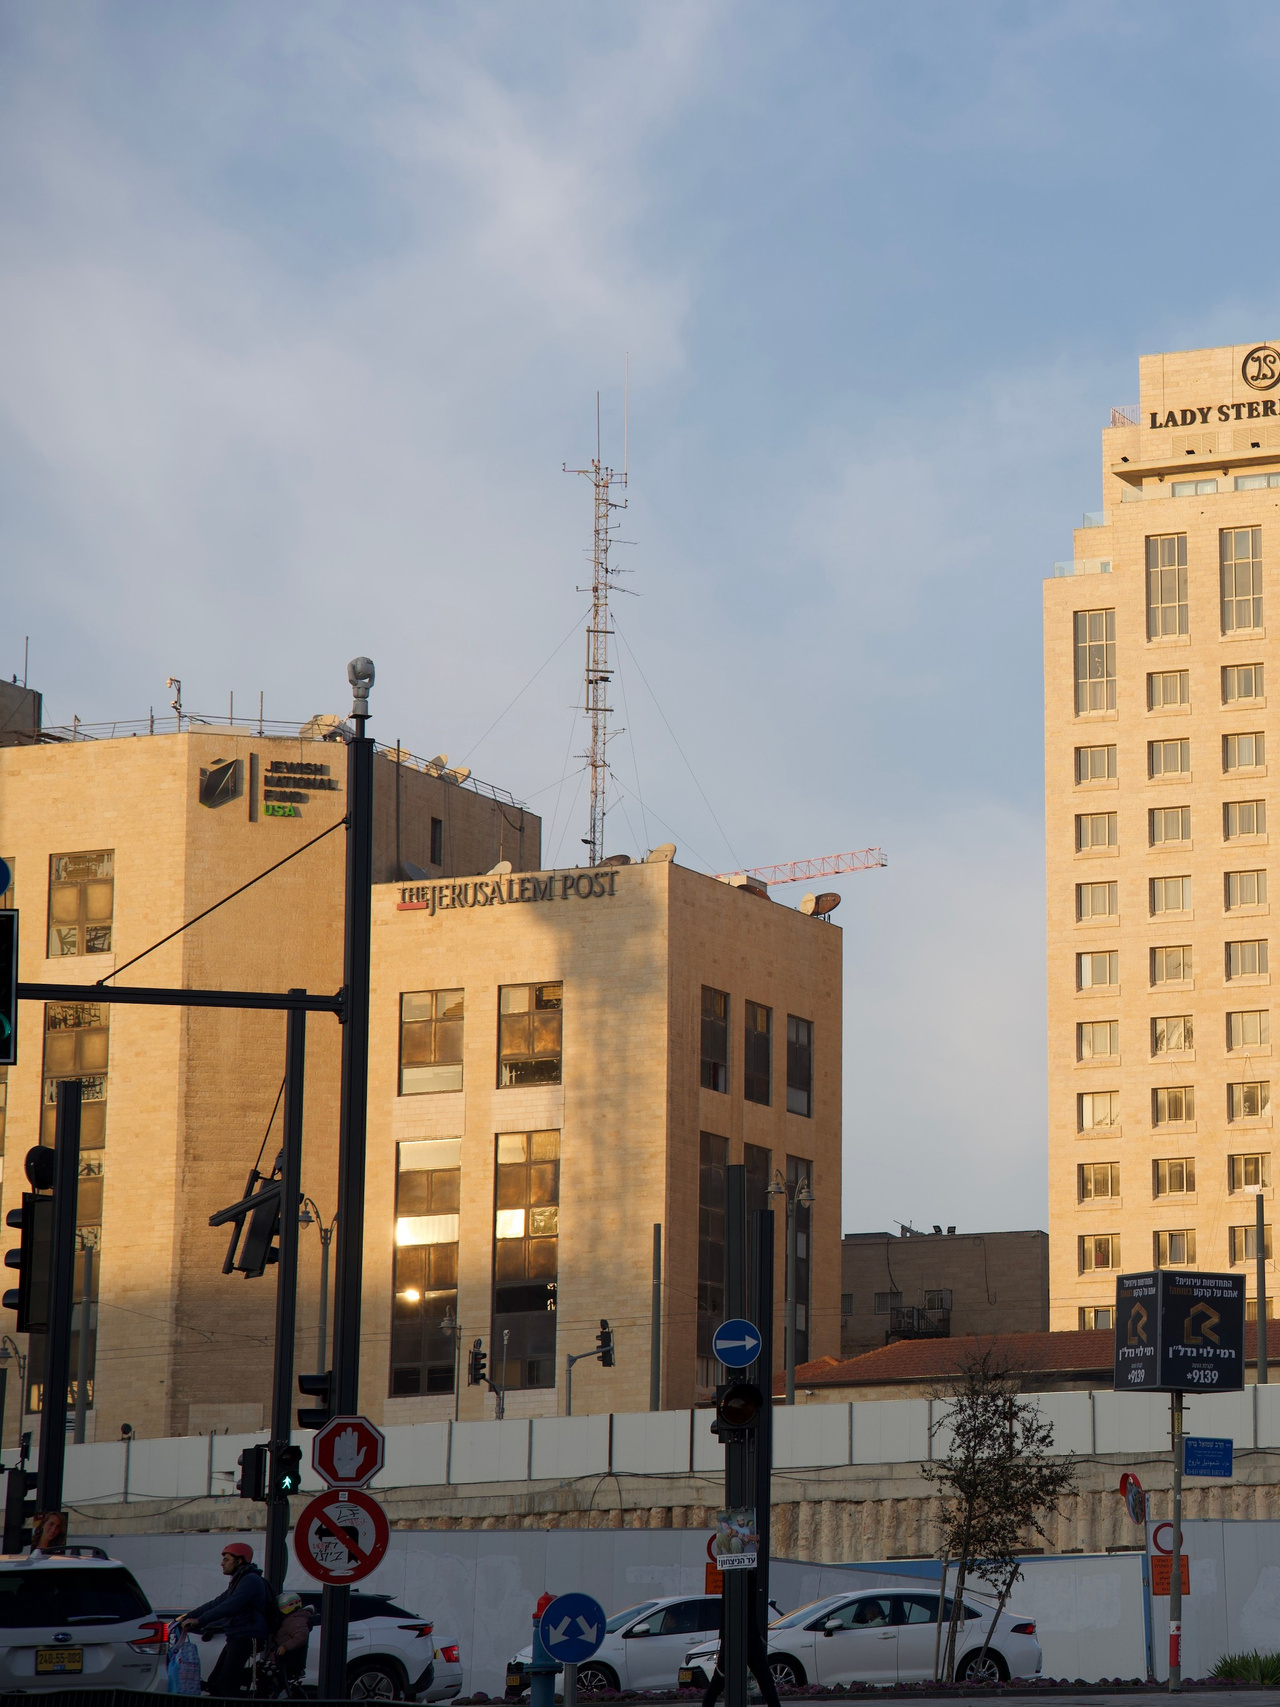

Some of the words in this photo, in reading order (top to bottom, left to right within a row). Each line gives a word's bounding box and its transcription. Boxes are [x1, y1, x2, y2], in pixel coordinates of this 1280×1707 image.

[1149, 407, 1211, 430] LADY
[265, 761, 324, 774] JEWISH
[264, 775, 336, 790] NATIONAL
[263, 803, 296, 817] USA
[397, 886, 428, 905] THE
[427, 875, 556, 916] JERUSALEM
[560, 870, 619, 900] POST
[1175, 1276, 1202, 1286] עירונית?
[1202, 1277, 1233, 1288] התחדשות
[1193, 1288, 1212, 1298] קרקע
[1213, 1288, 1222, 1297] על
[1222, 1290, 1238, 1298] אתם
[1199, 1346, 1214, 1358] לוי
[1216, 1347, 1236, 1359] רמי
[718, 1558, 745, 1568] הניצחון!
